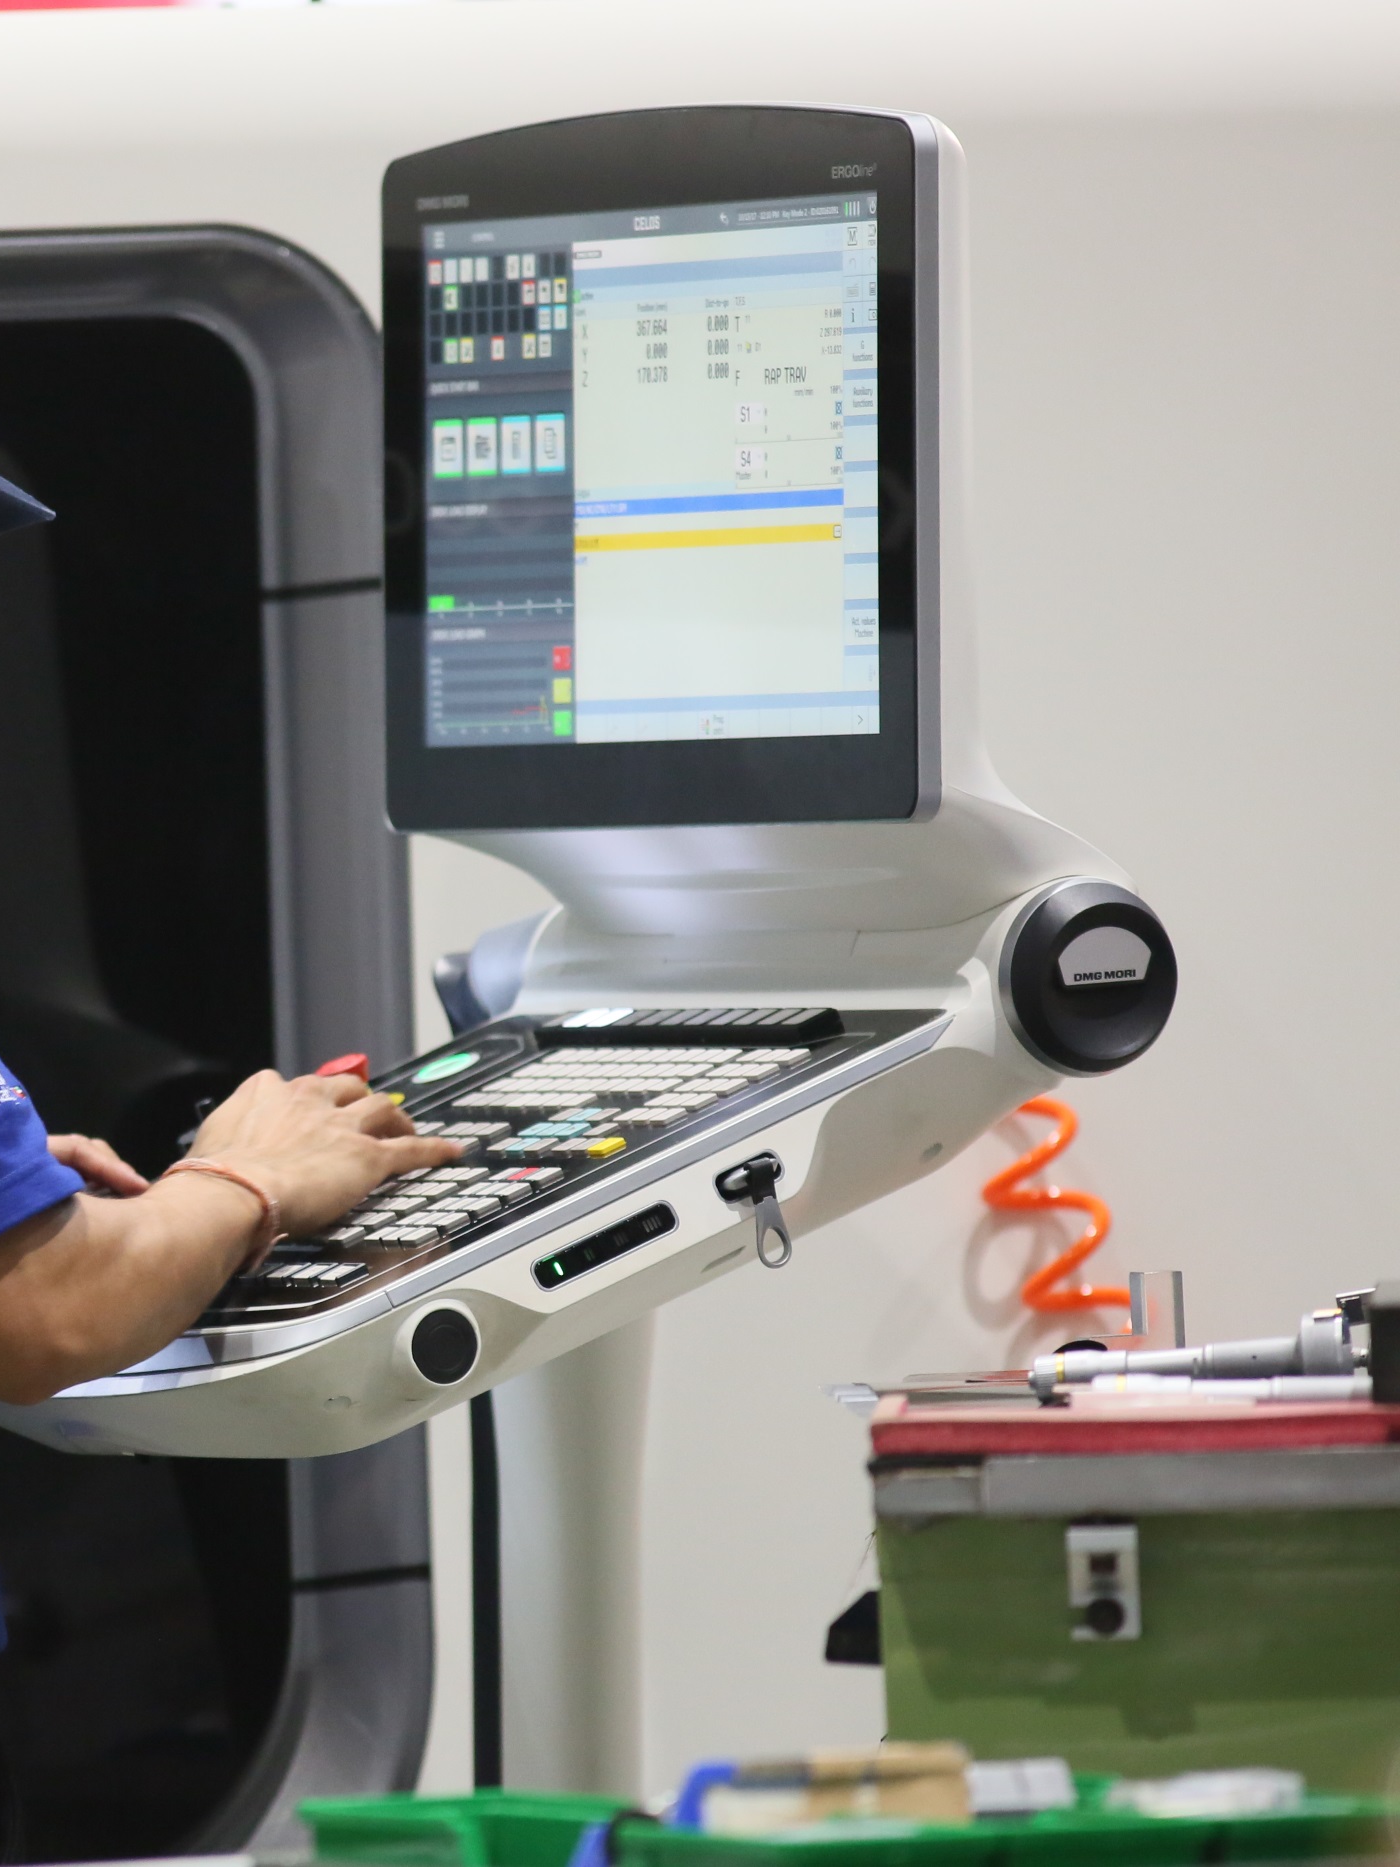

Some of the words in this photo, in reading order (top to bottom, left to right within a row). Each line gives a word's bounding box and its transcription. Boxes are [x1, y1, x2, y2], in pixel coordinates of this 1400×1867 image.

[764, 368, 782, 385] RAP
[784, 366, 807, 384] TRAV
[1073, 972, 1102, 982] DMG
[1104, 969, 1136, 979] MORI
